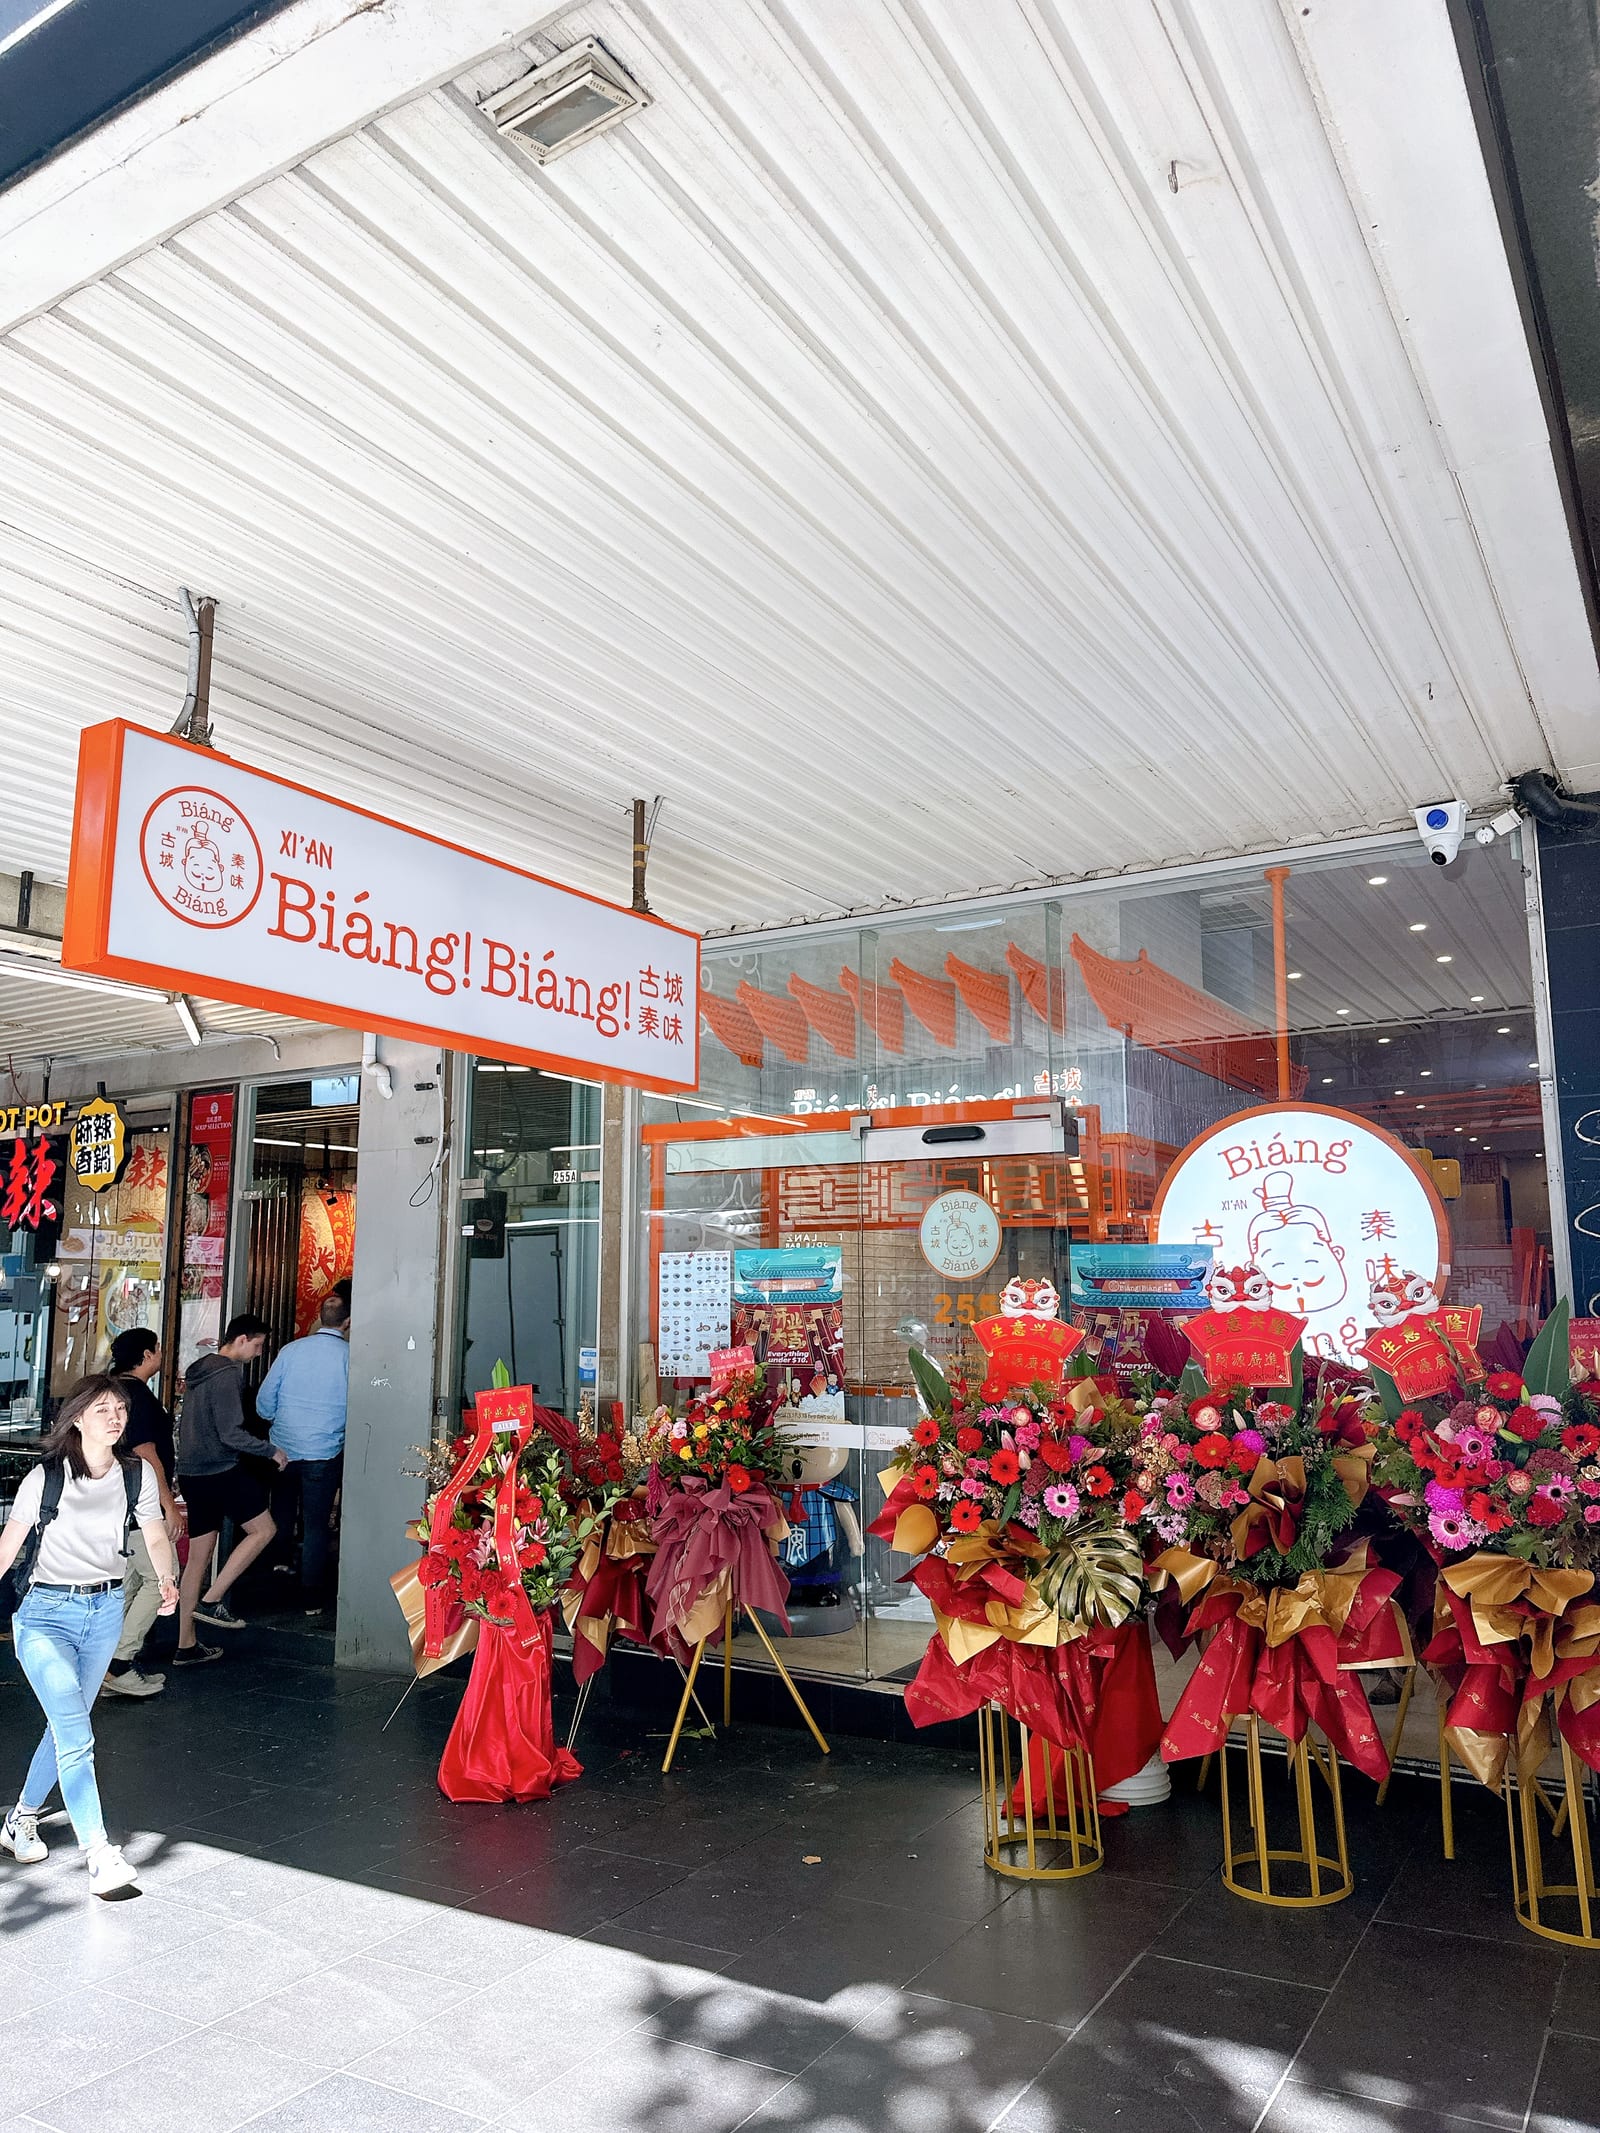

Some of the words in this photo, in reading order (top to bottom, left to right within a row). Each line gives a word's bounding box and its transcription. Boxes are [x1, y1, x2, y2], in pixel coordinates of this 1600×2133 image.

[178, 800, 235, 833] Biáng
[159, 831, 177, 869] 古城
[172, 885, 229, 917] Biáng
[267, 872, 471, 996] Biáng!
[481, 938, 631, 1038] Biáng!
[638, 965, 684, 1007] 古城
[638, 1005, 684, 1045] 秦味
[25, 1100, 66, 1129] POT
[1217, 1131, 1354, 1181] Biáng
[553, 1171, 577, 1183] 255A
[941, 1198, 979, 1214] Biáng
[1221, 1199, 1248, 1211] XI'AN
[941, 1256, 979, 1272] Biáng
